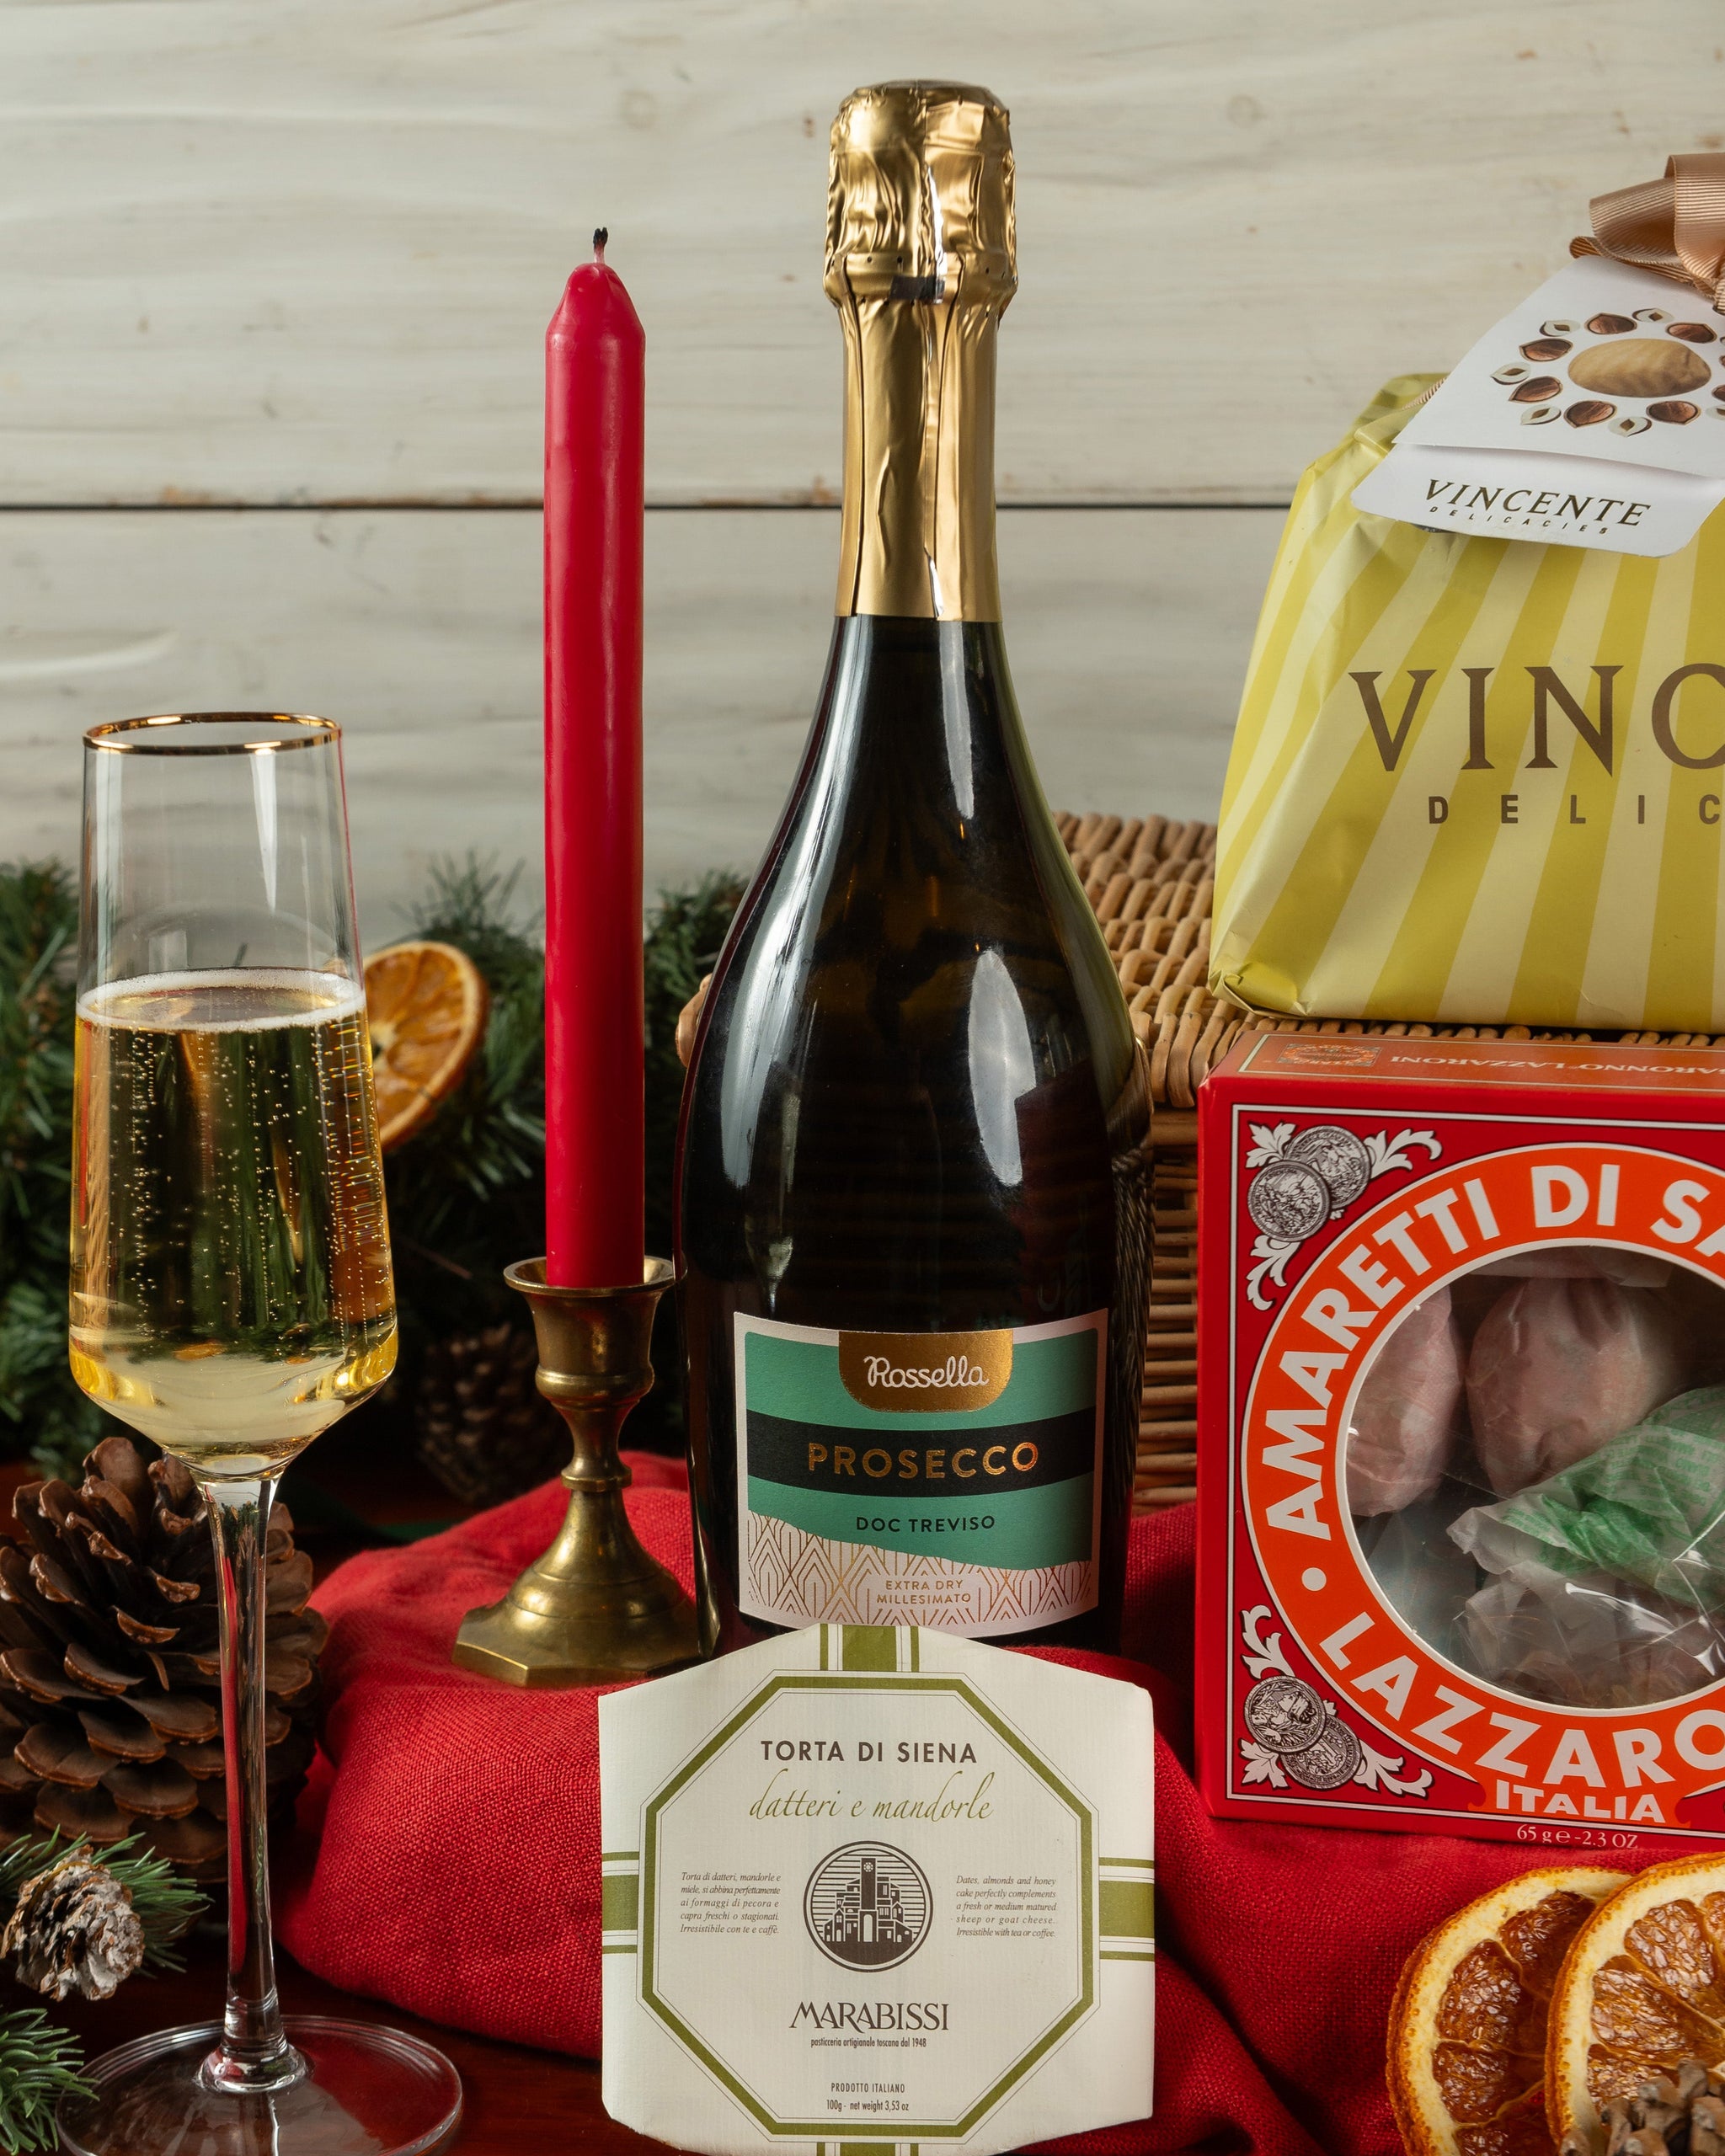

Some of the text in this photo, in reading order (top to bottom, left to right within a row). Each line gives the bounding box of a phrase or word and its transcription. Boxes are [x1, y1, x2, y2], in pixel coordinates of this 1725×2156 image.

[1426, 479, 1651, 526] VINCENTE
[1429, 506, 1608, 535] DELICACIES
[1348, 663, 1725, 777] VINC
[1429, 794, 1721, 825] DELIC
[1390, 1056, 1565, 1069] LAZZARONI
[1262, 1177, 1501, 1540] AMARETTI
[1530, 1164, 1621, 1228] DI
[863, 1355, 990, 1388] Rossella
[809, 1442, 1039, 1479] PROSECCO
[857, 1515, 995, 1532] DOC TREVISO
[885, 1579, 963, 1590] EXTRA DRY
[876, 1593, 971, 1604] MILLESIMATO
[1319, 1612, 1725, 1788] LAZZARO
[761, 1741, 977, 1763] TORTA DI SIENA
[749, 1768, 995, 1822] datteri e mandorle
[1496, 1779, 1666, 1823] ITALIA
[1517, 1824, 1537, 1841] 65
[1612, 1833, 1638, 1849] OZ
[681, 1872, 701, 1881] Torta
[702, 1872, 710, 1881] di
[712, 1872, 737, 1881] datteri,
[740, 1873, 774, 1881] mandorle
[956, 1876, 978, 1885] Dates,
[983, 1876, 1014, 1884] almonds
[1033, 1876, 1056, 1886] honey
[681, 1885, 701, 1894] miele,
[709, 1885, 733, 1893] abbina
[734, 1886, 781, 1896] perfettamente
[956, 1888, 1056, 1899] cake perfectly complements
[690, 1897, 729, 1908] formaggi
[732, 1898, 740, 1907] di
[742, 1900, 772, 1909] pecora
[962, 1902, 981, 1912] fresh
[994, 1902, 1023, 1911] medium
[1026, 1903, 1057, 1911] matured
[681, 1913, 702, 1921] capra
[703, 1911, 730, 1922] freschi
[740, 1912, 779, 1922] stagionati.
[956, 1914, 982, 1925] sheep
[998, 1916, 1019, 1925] goat
[681, 1924, 724, 1933] Irresistibile
[956, 1928, 993, 1936] Irresistible
[995, 1928, 1010, 1936] with
[788, 2001, 949, 2033] MARABISSI
[811, 2036, 927, 2048] pasticceria artigianale toscana dal 1948
[830, 2083, 905, 2093] PRODOTTO ITALIANO
[826, 2100, 842, 2112] 100g
[850, 2101, 860, 2110] net
[862, 2100, 883, 2112] weight
[885, 2100, 900, 2111] 3,53
